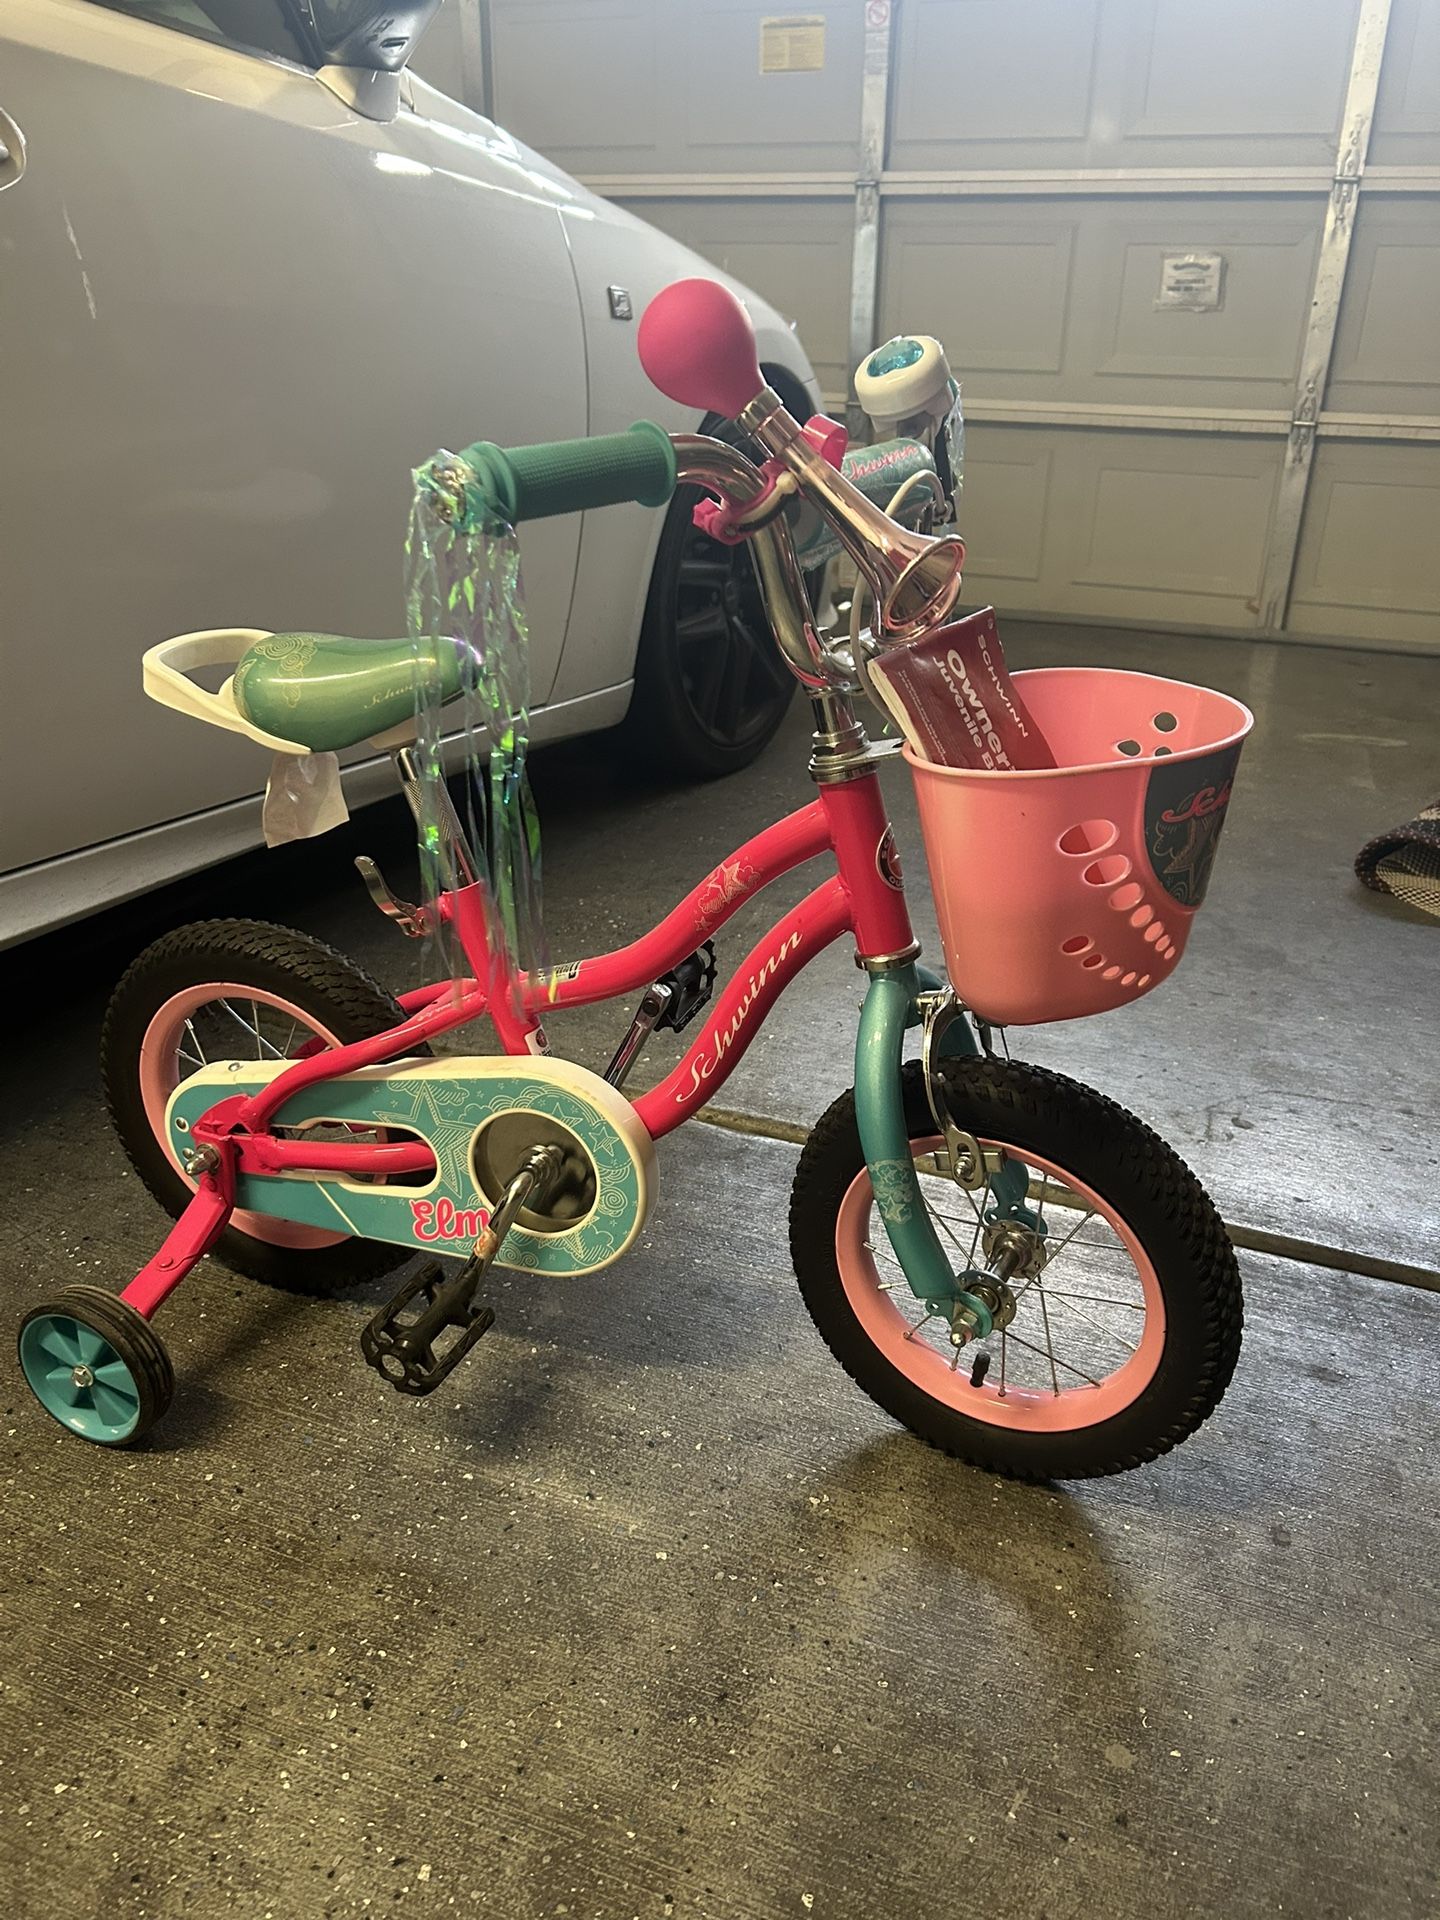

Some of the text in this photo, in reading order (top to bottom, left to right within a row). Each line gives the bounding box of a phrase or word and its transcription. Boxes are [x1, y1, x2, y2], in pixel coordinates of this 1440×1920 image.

[932, 656, 998, 771] Juvenile B
[946, 649, 1017, 771] Owner
[977, 634, 1029, 738] SCHWINN
[676, 931, 803, 1103] Schwinn
[408, 1196, 491, 1242] Elm
